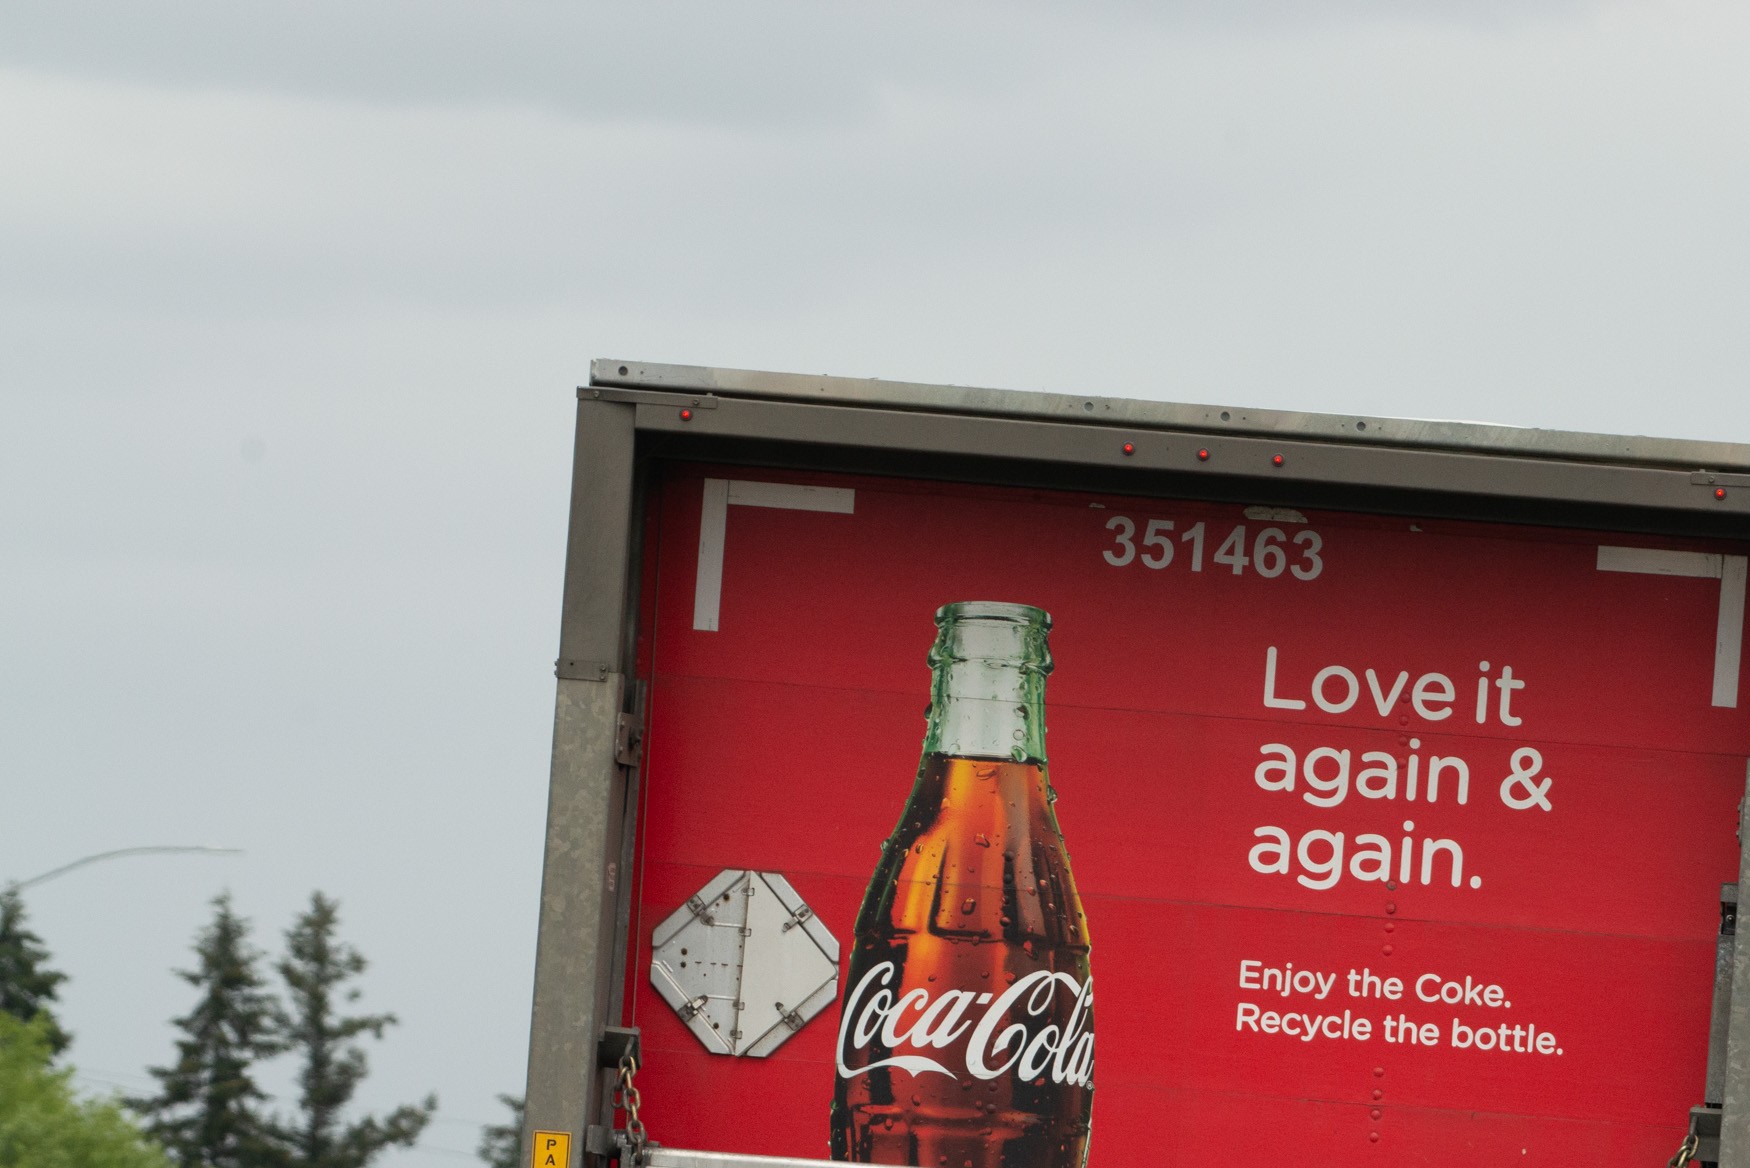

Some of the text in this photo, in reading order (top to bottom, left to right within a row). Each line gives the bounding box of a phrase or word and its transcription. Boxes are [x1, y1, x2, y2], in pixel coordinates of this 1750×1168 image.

[1102, 515, 1324, 581] 351463
[1263, 646, 1526, 727] Love it
[1253, 738, 1553, 812] again &
[1247, 820, 1482, 890] again.
[1238, 960, 1512, 1008] Enjoy the Coke.
[836, 960, 1095, 1087] Coca-Cola
[1235, 1002, 1564, 1055] Recycle the bottle.
